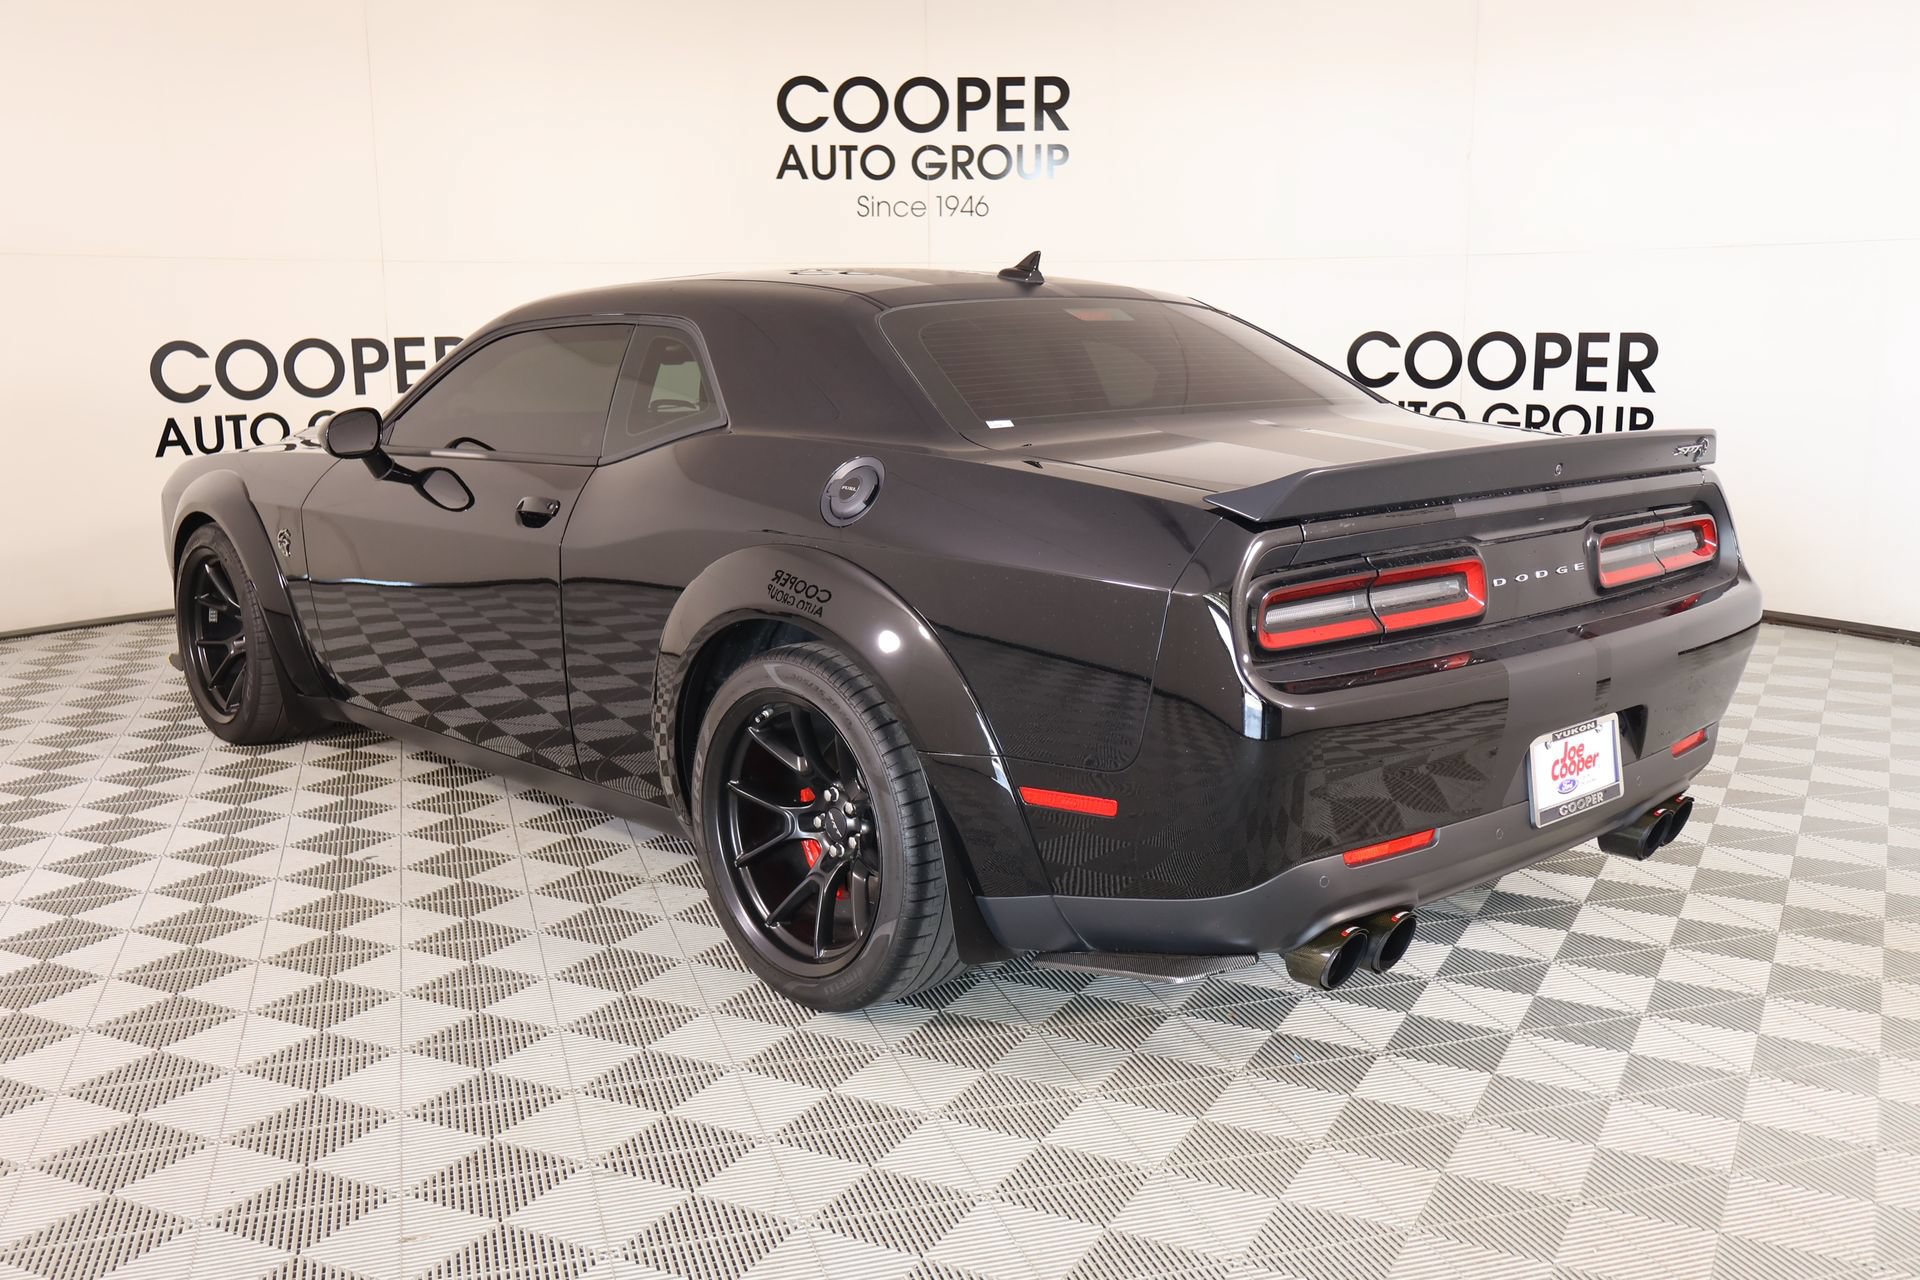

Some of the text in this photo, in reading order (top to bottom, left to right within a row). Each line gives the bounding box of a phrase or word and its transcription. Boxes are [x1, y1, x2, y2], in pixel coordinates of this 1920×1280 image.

[776, 75, 1070, 133] COOPER
[776, 144, 1070, 181] AUTO GROUP
[856, 195, 989, 217] Since 1946
[1347, 330, 1659, 393] COOPER
[155, 412, 290, 458] AUTO
[1492, 562, 1585, 587] DODGE
[1554, 721, 1596, 740] YUKON
[1561, 741, 1585, 763] Joe
[1551, 752, 1599, 781] Cooper
[1559, 791, 1604, 816] COOPER
